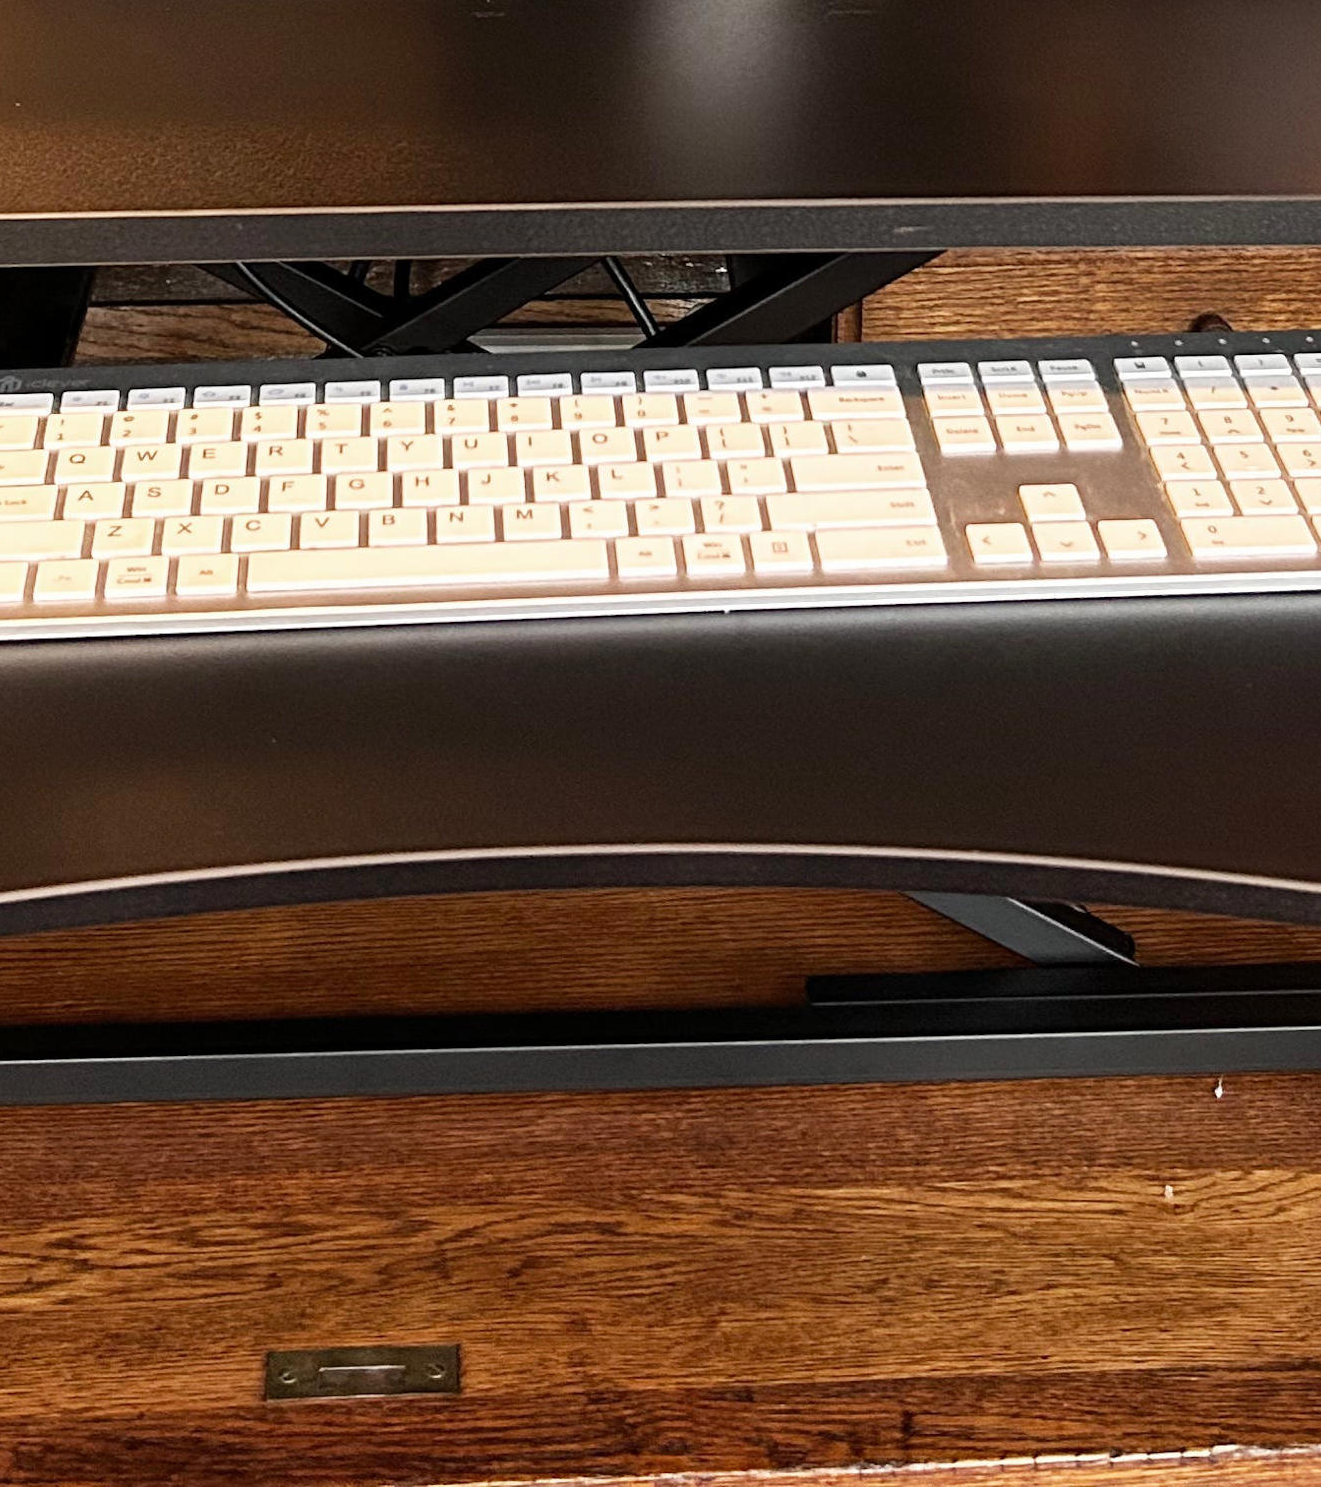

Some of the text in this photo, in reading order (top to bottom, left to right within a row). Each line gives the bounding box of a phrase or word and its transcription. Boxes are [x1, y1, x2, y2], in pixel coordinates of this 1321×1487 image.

[656, 432, 668, 441] P
[336, 443, 348, 454] T
[402, 441, 413, 451] Y
[465, 439, 477, 448] U
[203, 448, 216, 459] E
[269, 446, 282, 455] R
[70, 454, 85, 463] Q
[137, 451, 157, 461] W
[482, 474, 491, 484] J
[546, 473, 559, 481] K
[611, 469, 622, 480] L
[282, 482, 292, 491] F
[349, 480, 365, 489] G
[416, 477, 429, 486] H
[148, 487, 161, 497] S
[215, 485, 229, 494] D
[78, 490, 93, 500] A
[450, 513, 463, 522] N
[517, 509, 533, 519] M
[315, 517, 329, 528] V
[383, 515, 395, 525] B
[178, 523, 191, 534] X
[246, 521, 260, 531] C
[108, 526, 122, 537] Z
